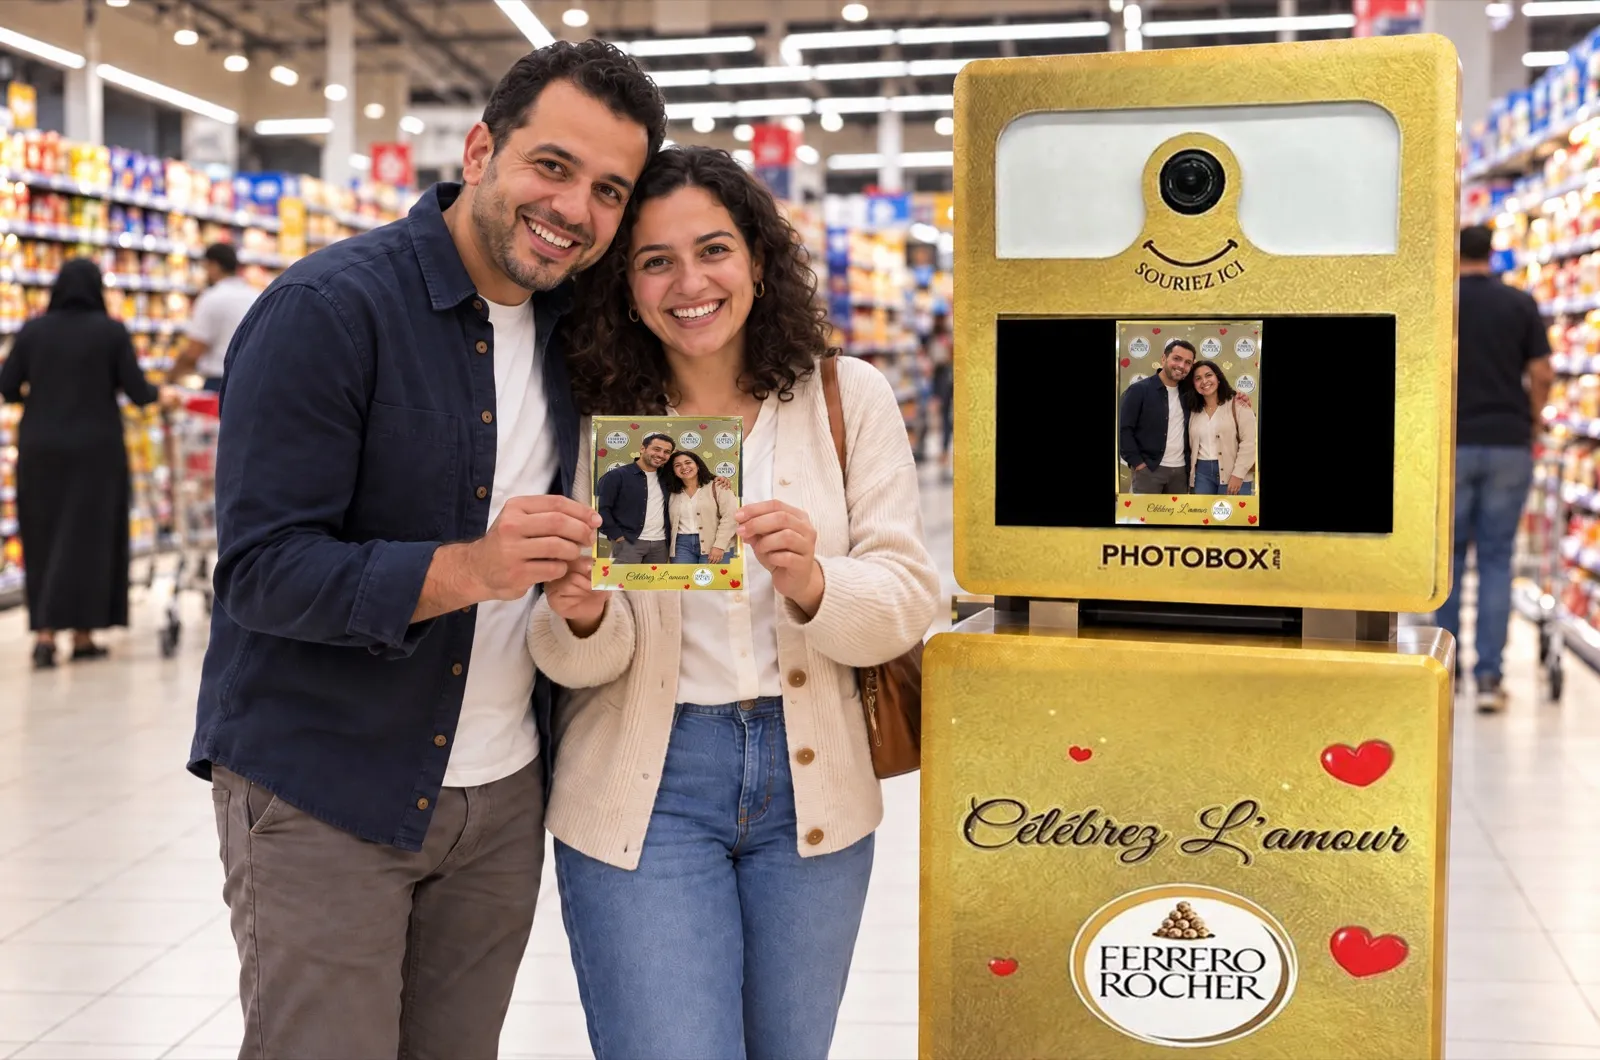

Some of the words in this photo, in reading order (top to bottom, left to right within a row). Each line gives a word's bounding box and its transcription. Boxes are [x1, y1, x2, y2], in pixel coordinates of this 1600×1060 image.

[1135, 262, 1215, 291] SOURIEZ
[1217, 260, 1245, 283] ICI
[1102, 544, 1269, 570] PHOTOBOX
[963, 797, 1168, 864] Célébrez
[1180, 799, 1409, 865] L'amour
[1101, 945, 1266, 974] FERRERO
[1100, 972, 1266, 1000] ROCHER
